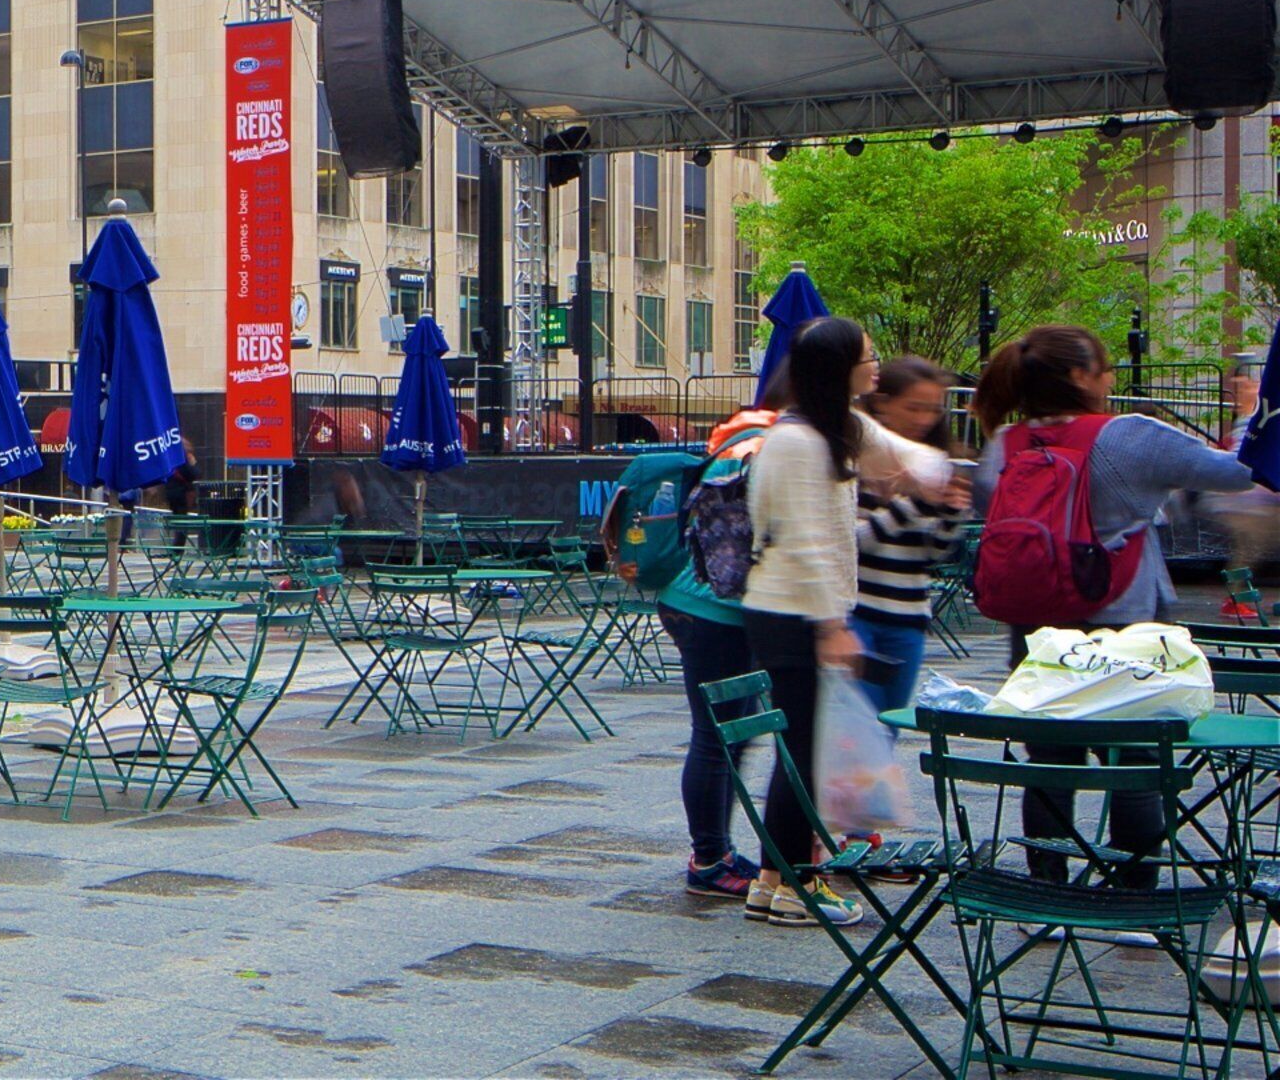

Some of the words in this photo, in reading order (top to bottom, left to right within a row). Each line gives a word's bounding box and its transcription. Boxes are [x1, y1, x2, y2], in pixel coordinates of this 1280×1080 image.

[236, 99, 283, 114] CINCINNATI
[236, 112, 283, 140] REDS
[238, 188, 249, 214] beer
[239, 224, 252, 262] games
[238, 271, 249, 298] food
[237, 322, 284, 336] CINCINNATI
[237, 336, 284, 362] REDS
